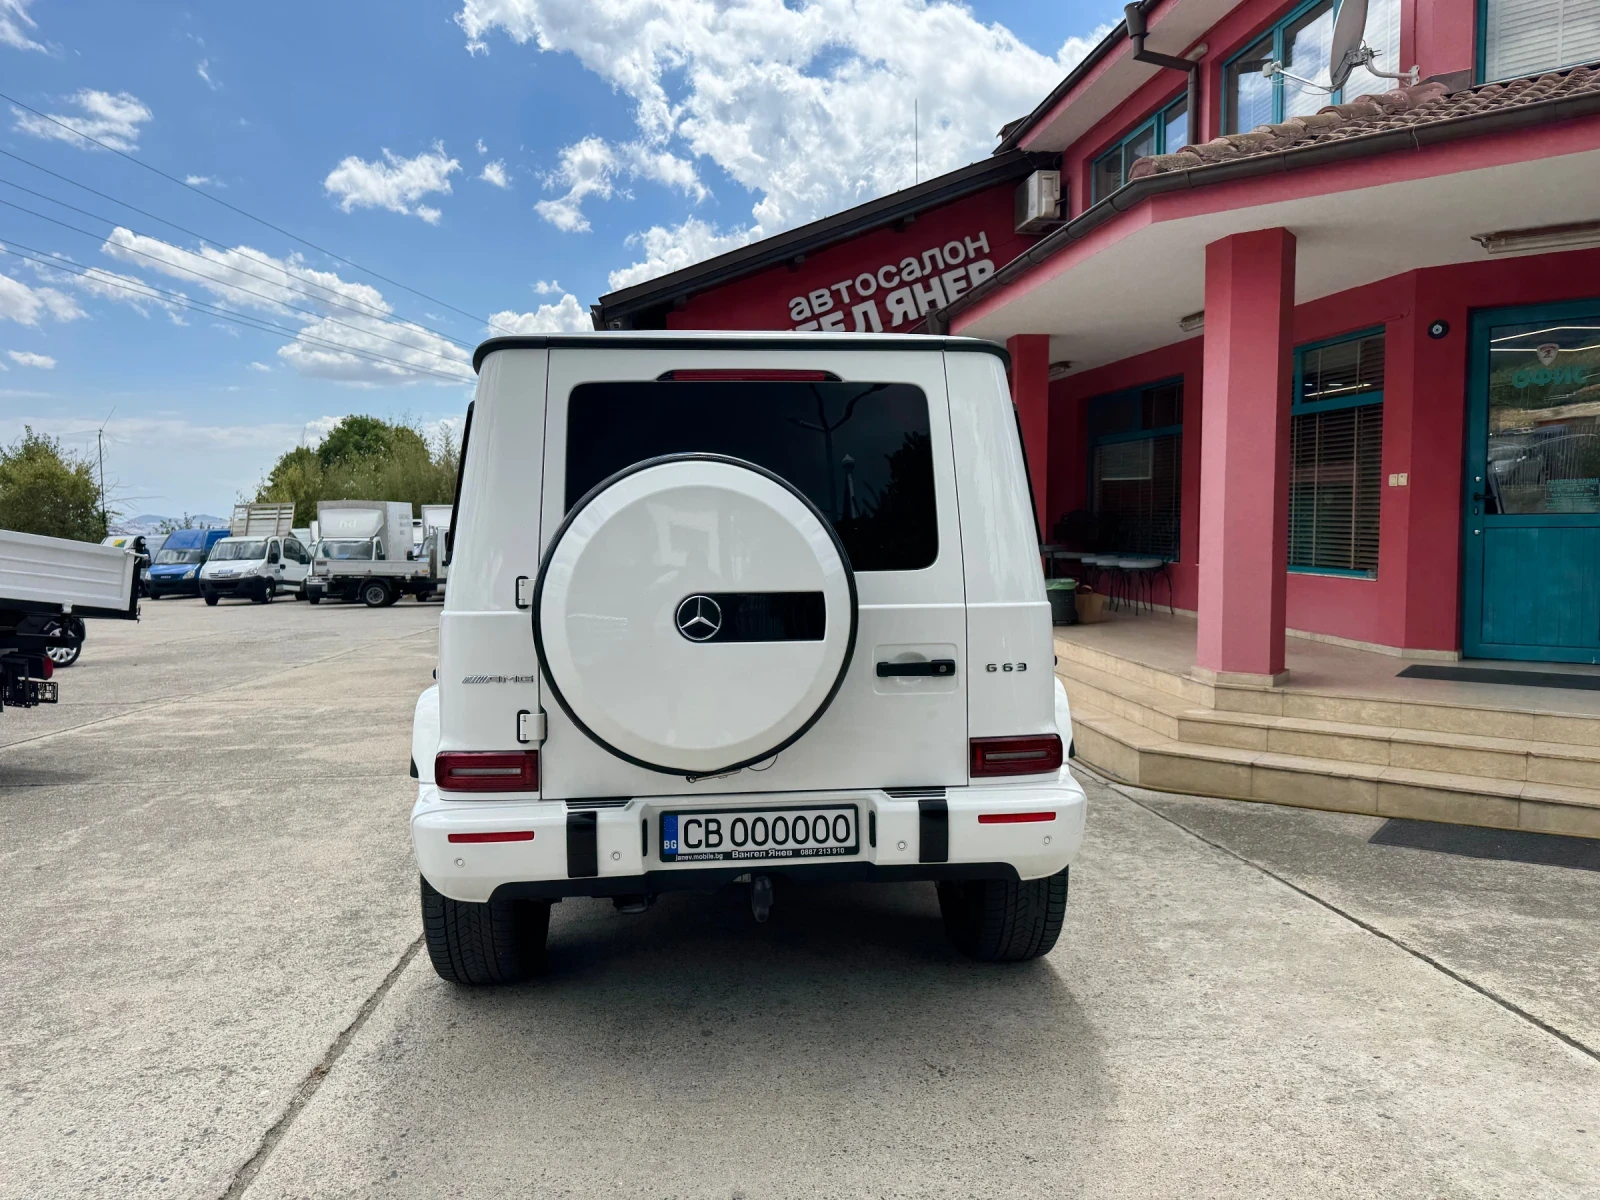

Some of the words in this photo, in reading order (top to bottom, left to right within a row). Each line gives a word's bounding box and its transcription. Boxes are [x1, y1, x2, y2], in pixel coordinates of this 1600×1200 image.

[788, 231, 990, 321] автосалон
[683, 818, 723, 849] CB
[730, 814, 850, 847] 000000
[663, 840, 677, 849] BG
[732, 850, 766, 859] Вангел
[768, 848, 792, 857] Янев
[800, 848, 817, 856] 0887
